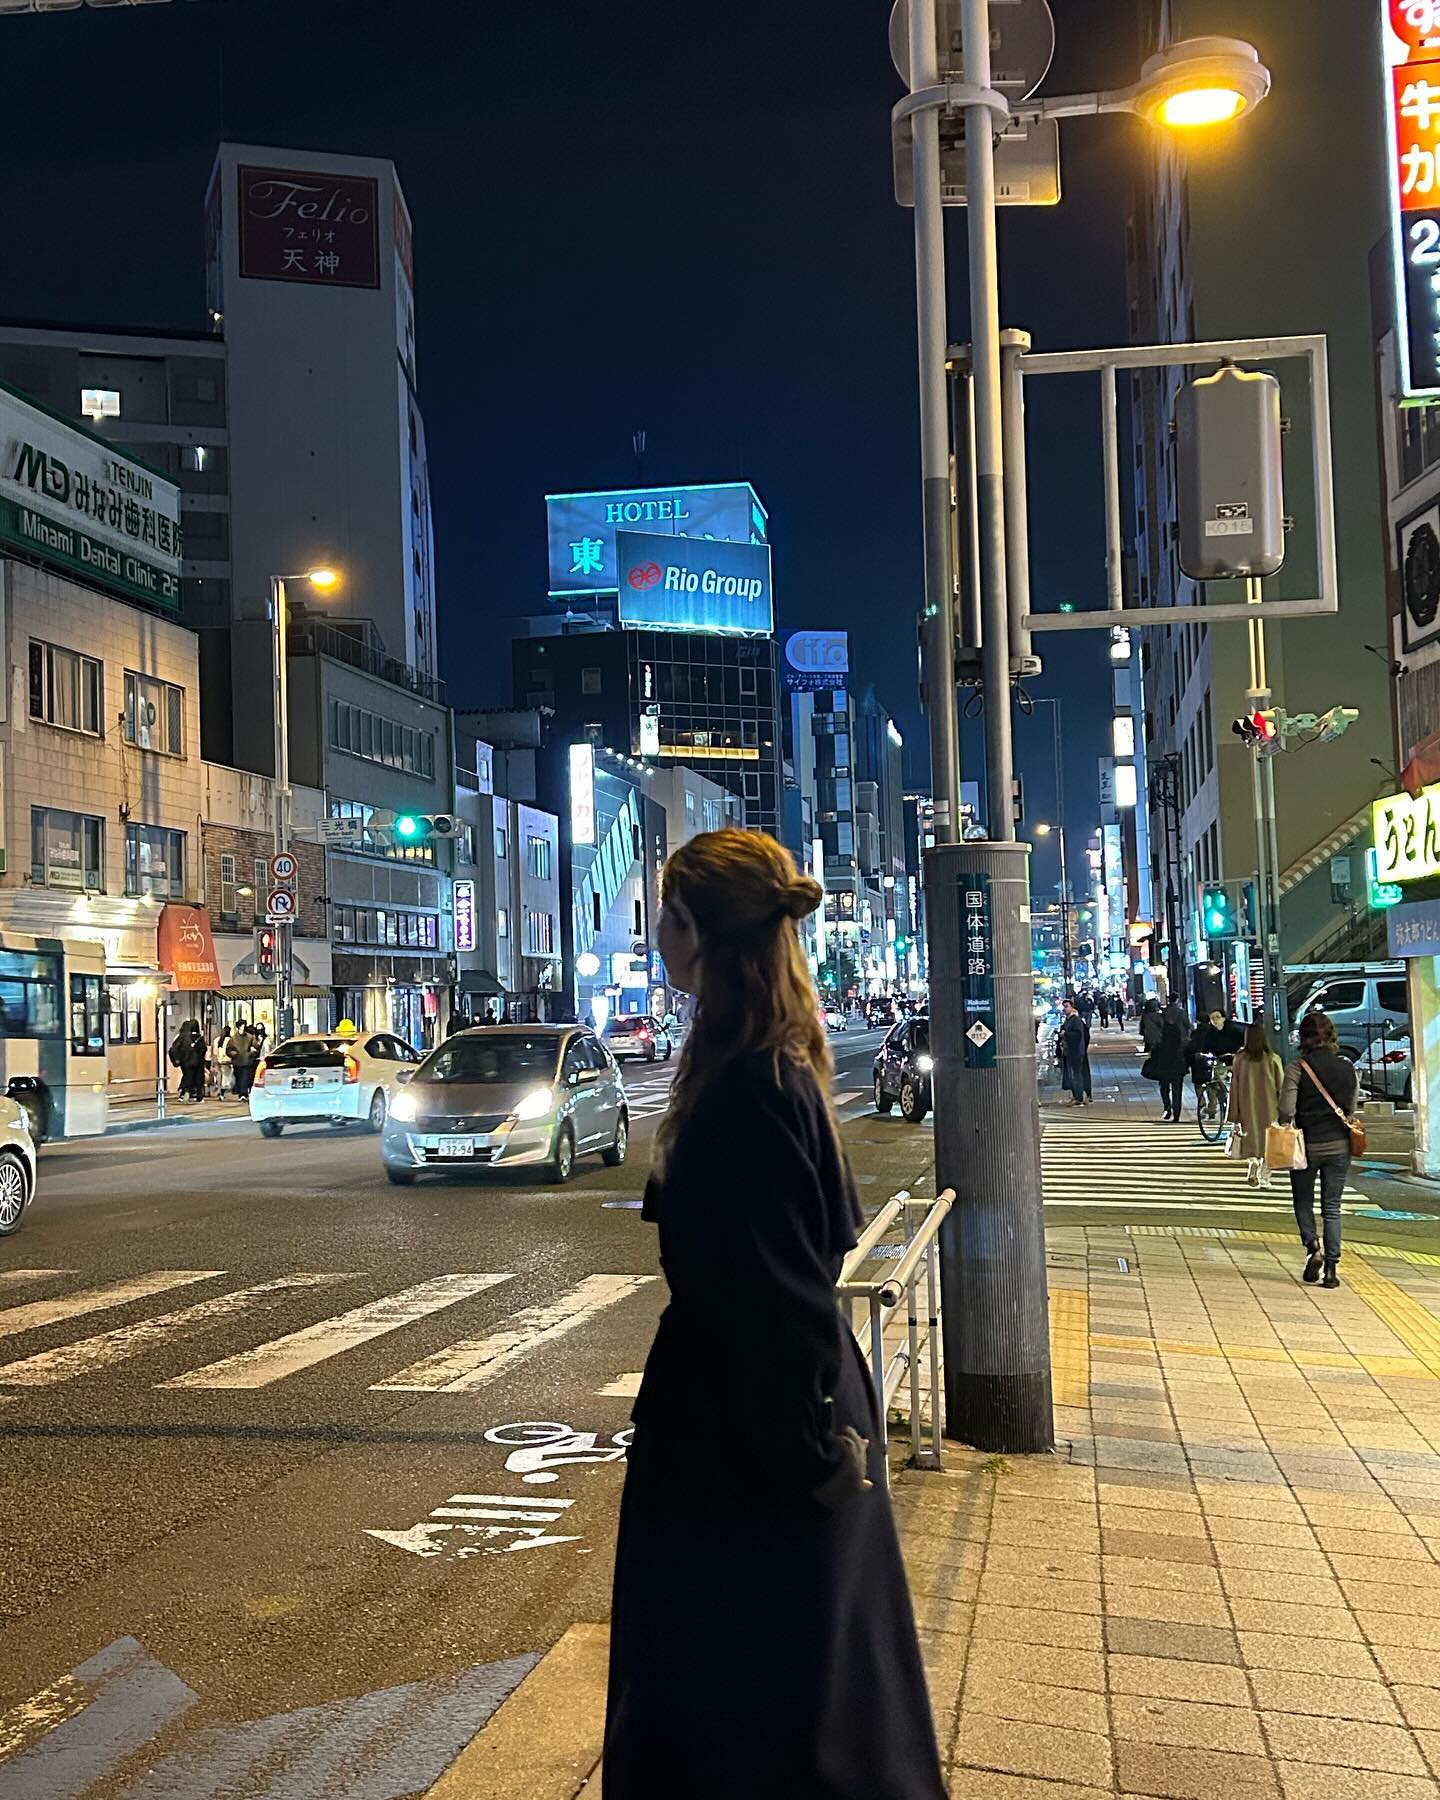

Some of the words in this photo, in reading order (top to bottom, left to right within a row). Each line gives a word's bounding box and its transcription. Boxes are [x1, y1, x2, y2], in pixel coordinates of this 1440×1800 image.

[249, 180, 369, 224] Felio
[282, 227, 336, 244] フェリオ
[1410, 218, 1440, 265] 2
[281, 249, 340, 276] 天神
[111, 461, 153, 500] TENJIN
[605, 499, 689, 523] HOTEL
[23, 510, 74, 556] Minami
[80, 536, 121, 576] Dental
[126, 558, 157, 591] Clinic
[162, 573, 179, 598] 2F
[569, 536, 605, 574] 東
[665, 566, 699, 593] Rio
[701, 569, 763, 602] Group
[276, 860, 292, 873] 40
[966, 891, 986, 975] 国体道路
